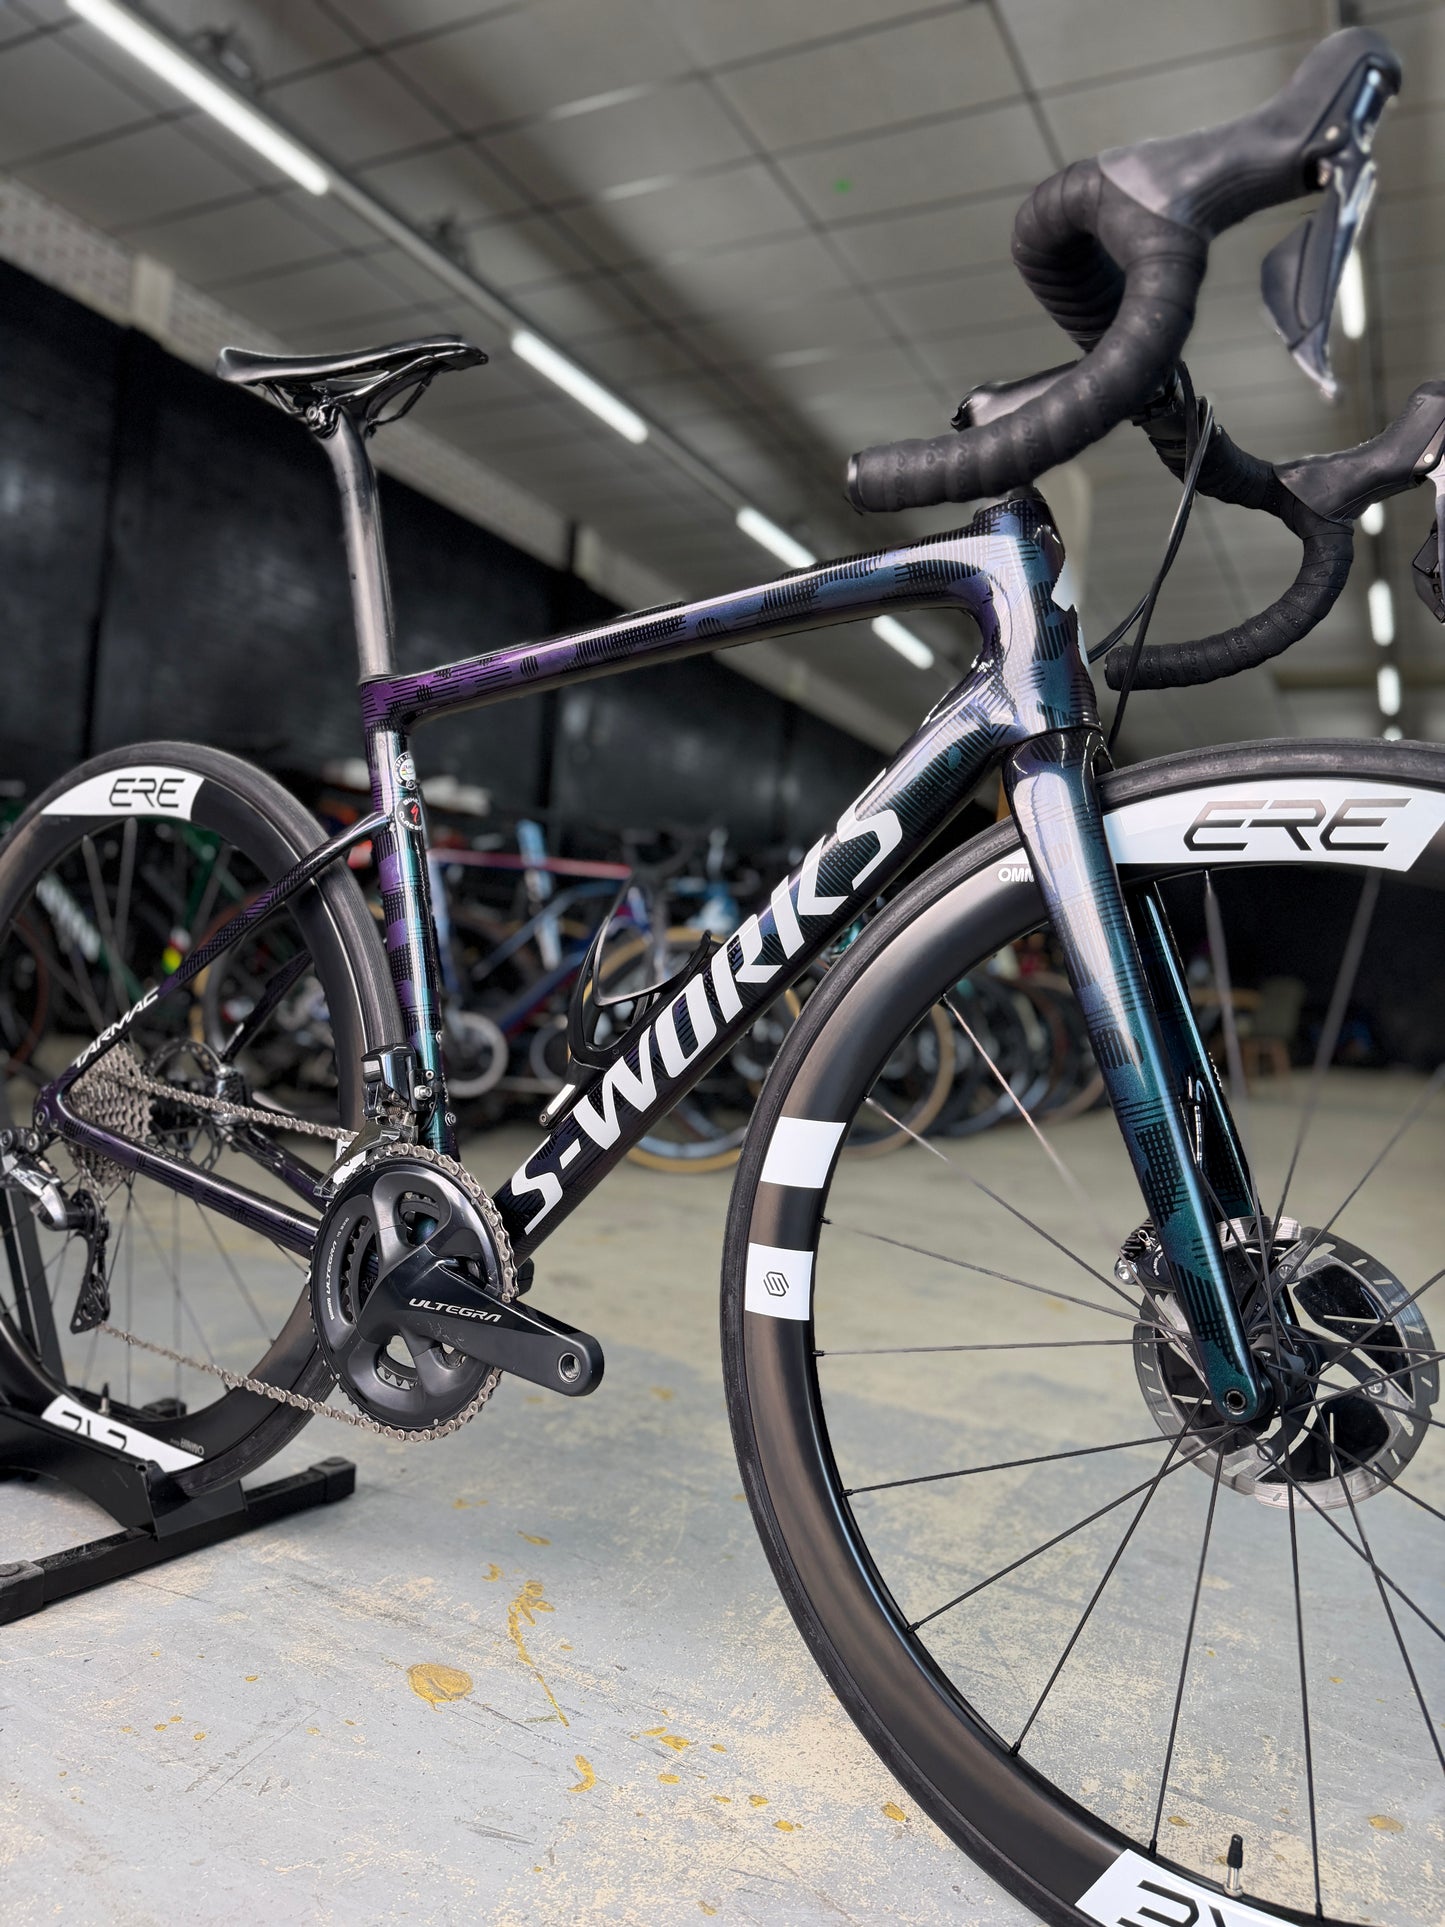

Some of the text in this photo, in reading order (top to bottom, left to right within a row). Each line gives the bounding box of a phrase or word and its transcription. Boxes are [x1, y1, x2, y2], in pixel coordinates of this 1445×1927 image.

[109, 778, 186, 808] ERE
[1183, 797, 1413, 852] ERE
[71, 985, 159, 1069] TARMAC
[511, 767, 903, 1236] S-WORKS
[325, 1240, 337, 1295] ULTEGRA
[408, 1297, 502, 1323] ULTEGRA
